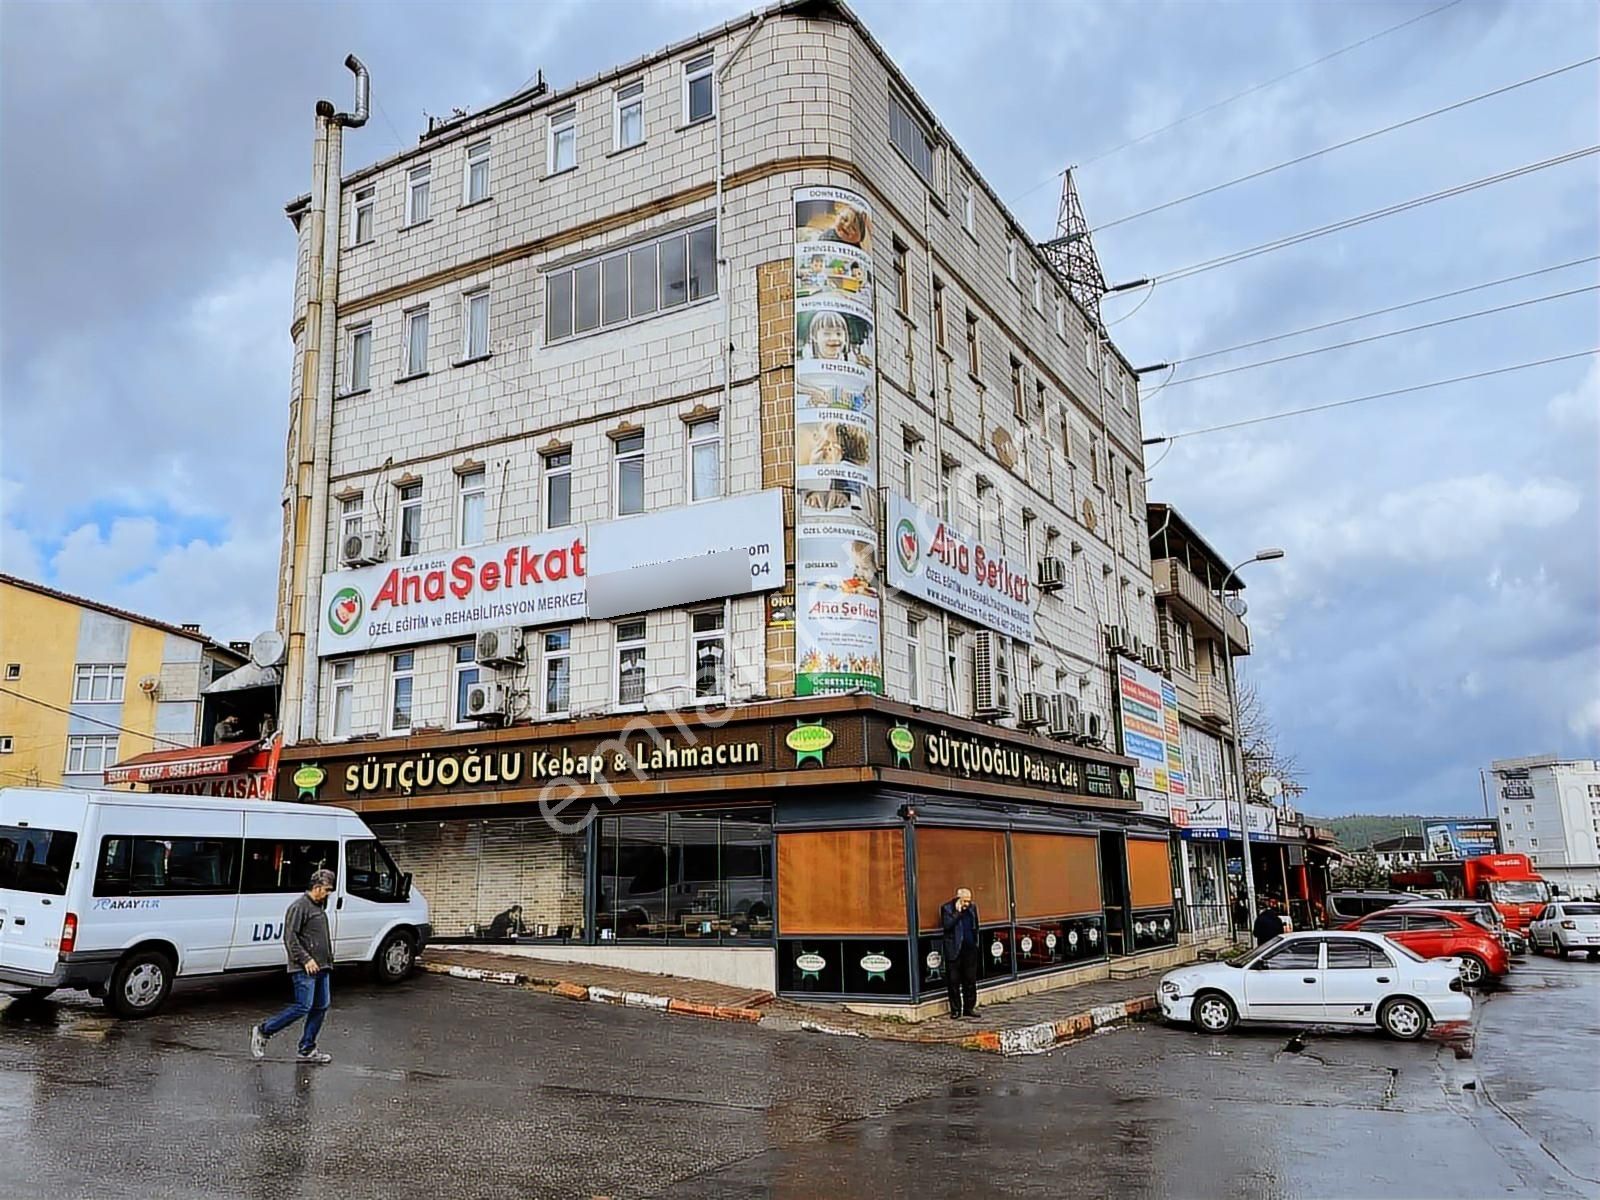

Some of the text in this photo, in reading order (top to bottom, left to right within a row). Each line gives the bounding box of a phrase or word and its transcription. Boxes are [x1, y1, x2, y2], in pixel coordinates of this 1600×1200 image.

[926, 522, 1031, 607] Ana Şefkat
[368, 616, 393, 637] ÖZEL
[395, 613, 429, 633] EĞİTİM
[430, 616, 443, 627] ve
[444, 599, 535, 626] REHABİLİTASYON
[808, 601, 839, 614] Ana
[841, 602, 878, 620] Şefkat
[345, 748, 521, 795] SÜTÇÜOĞLU
[531, 747, 604, 784] Kebap
[613, 751, 628, 772] &
[636, 738, 760, 772] Lahmacun
[928, 729, 1020, 778] SÜTÇÜOĞLU
[1023, 755, 1050, 780] Pasta
